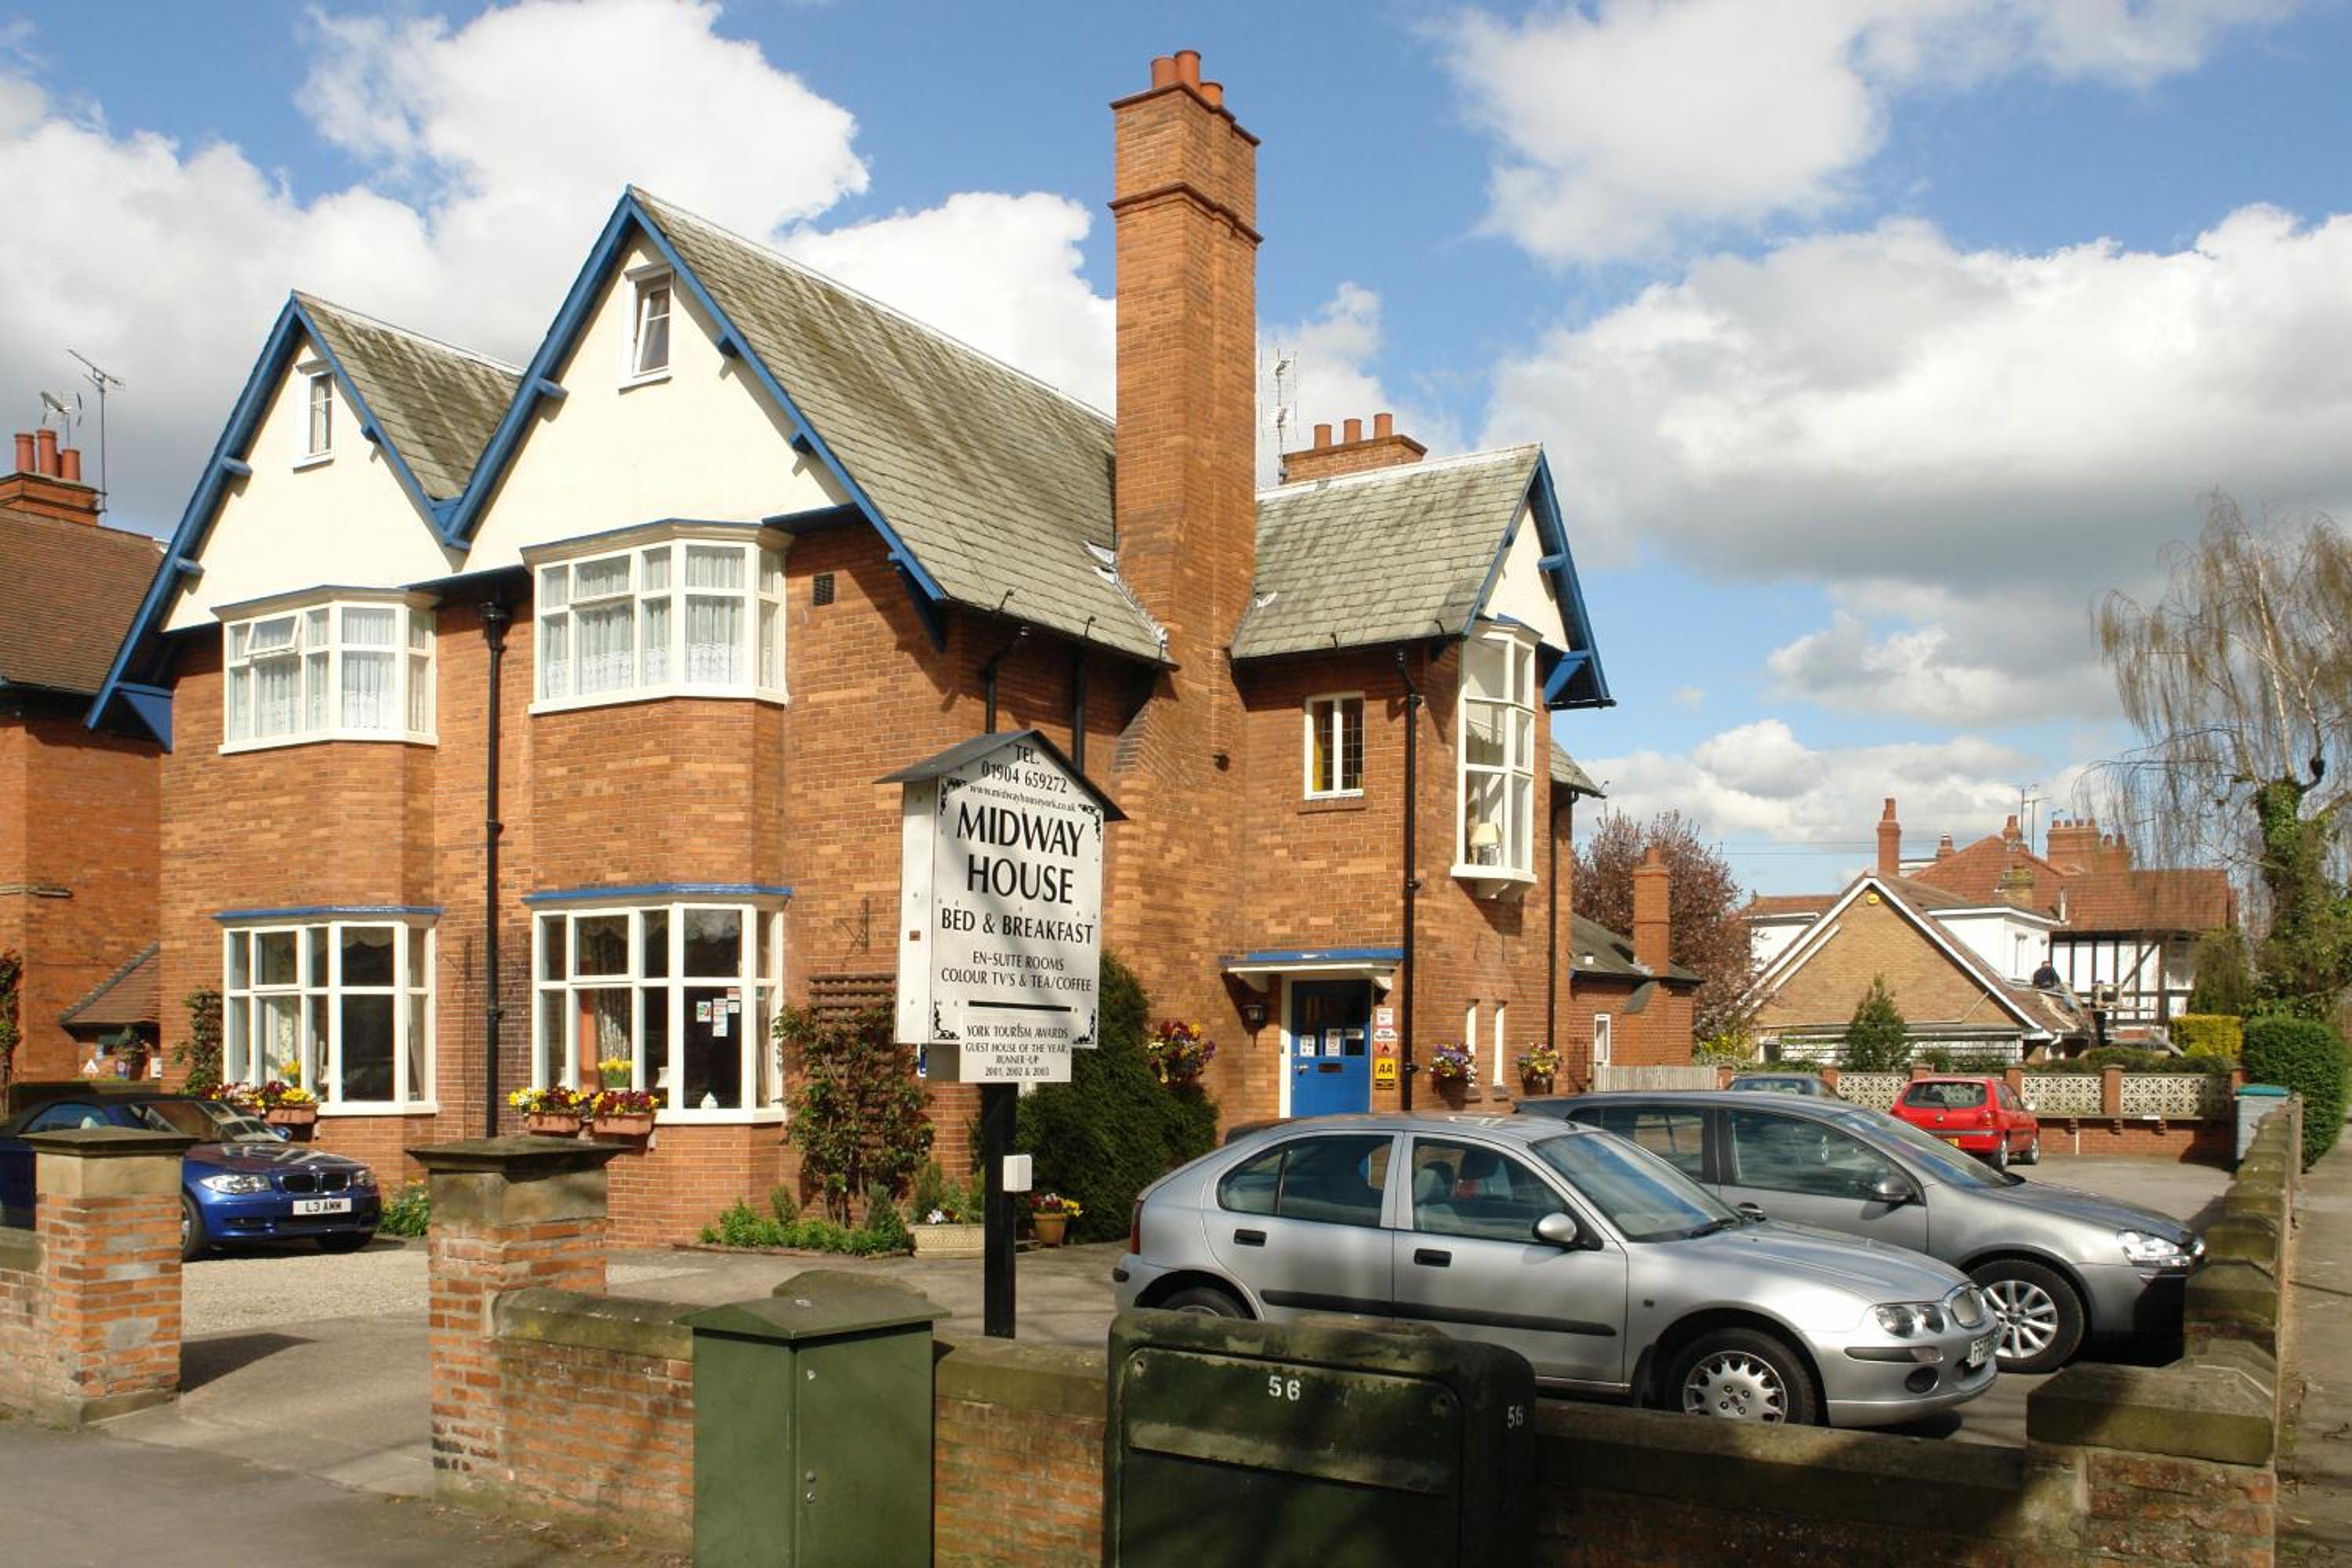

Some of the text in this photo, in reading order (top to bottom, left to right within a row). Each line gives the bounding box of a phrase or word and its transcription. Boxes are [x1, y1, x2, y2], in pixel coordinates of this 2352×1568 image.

[1015, 745, 1040, 764] TEL.
[982, 760, 1067, 793] 01904 659272
[956, 800, 1085, 857] MIDWAY
[967, 854, 1074, 904] HOUSE
[942, 907, 1094, 944] BED & BREAKFAST
[973, 950, 1065, 971] EN-SUITE ROOMS
[942, 967, 1091, 992] COLOUR TV'S & TEA/COFFEE
[967, 1025, 1069, 1039] YORK TOURISM AWARDS
[965, 1042, 989, 1052] GUEST
[992, 1043, 1016, 1052] HOUSE
[1019, 1044, 1029, 1052] OF
[1032, 1044, 1044, 1052] THE
[1025, 1067, 1030, 1076] &
[1378, 1063, 1392, 1074] AA
[305, 1201, 320, 1213] L3
[1268, 1375, 1301, 1401] 56
[1508, 1405, 1523, 1428] 56
